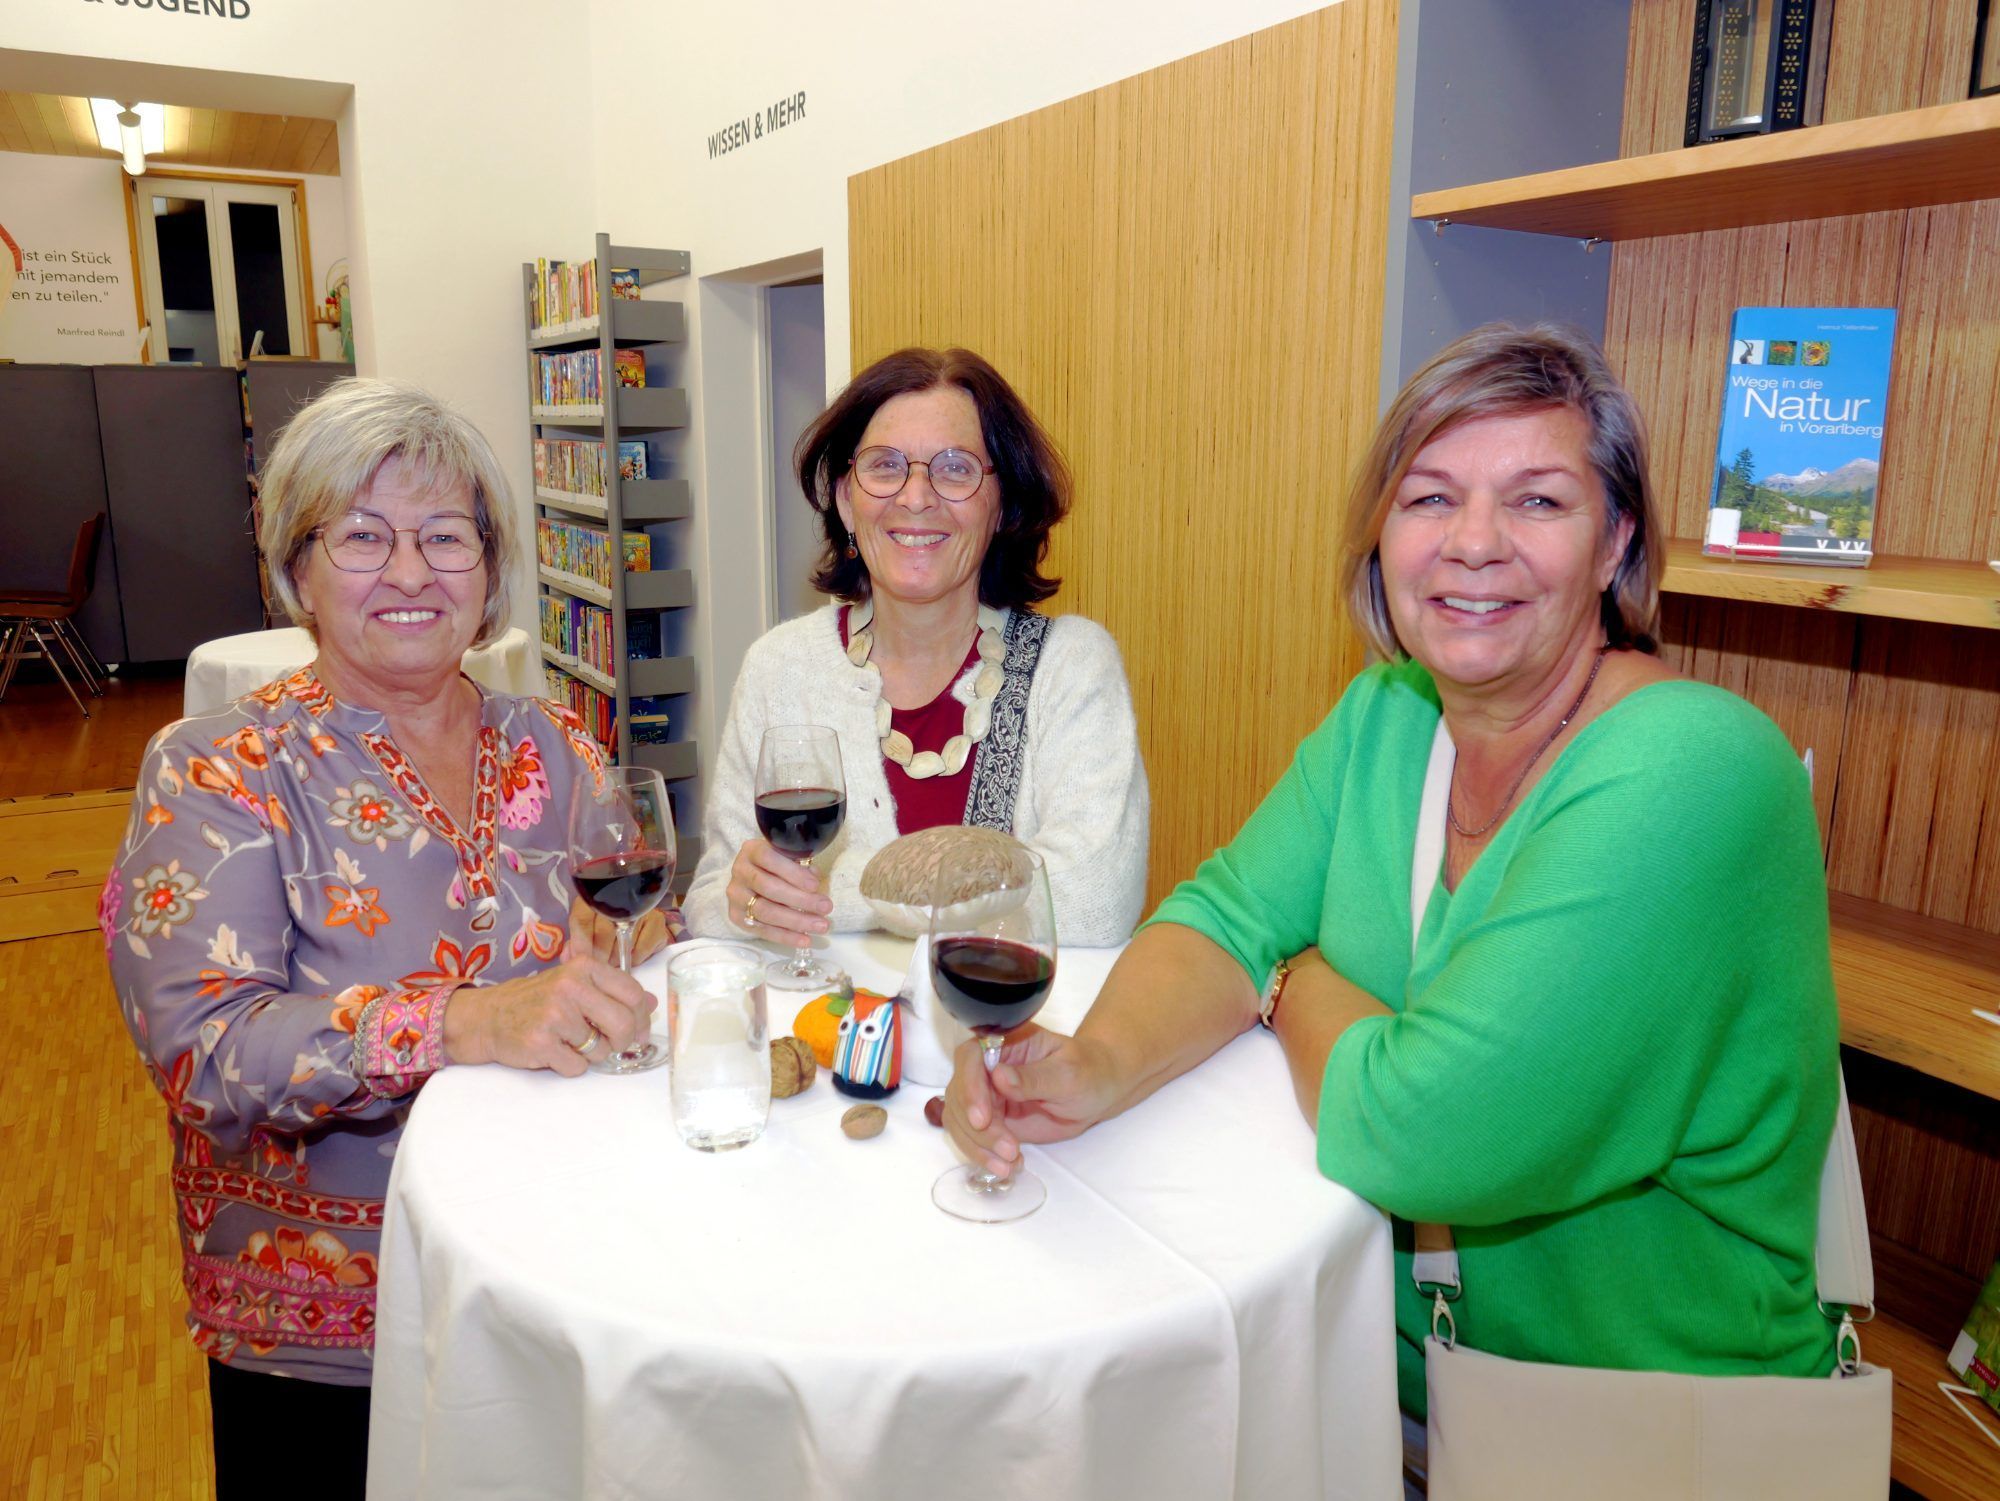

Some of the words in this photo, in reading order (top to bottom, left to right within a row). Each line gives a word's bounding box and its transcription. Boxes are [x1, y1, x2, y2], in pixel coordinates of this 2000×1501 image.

[708, 117, 750, 160] WISSEN
[754, 112, 763, 140] &
[767, 91, 806, 134] MEHR
[44, 250, 67, 263] ein
[71, 250, 112, 265] Stück
[40, 269, 119, 285] jemandem
[9, 290, 31, 301] en
[35, 291, 52, 301] zu
[57, 327, 95, 337] Manfred
[1732, 376, 1778, 390] Wege
[1782, 377, 1796, 389] in
[1800, 378, 1823, 389] die
[1744, 388, 1871, 421] Natur
[1780, 421, 1793, 432] in
[1798, 422, 1883, 438] Vorarlberg
